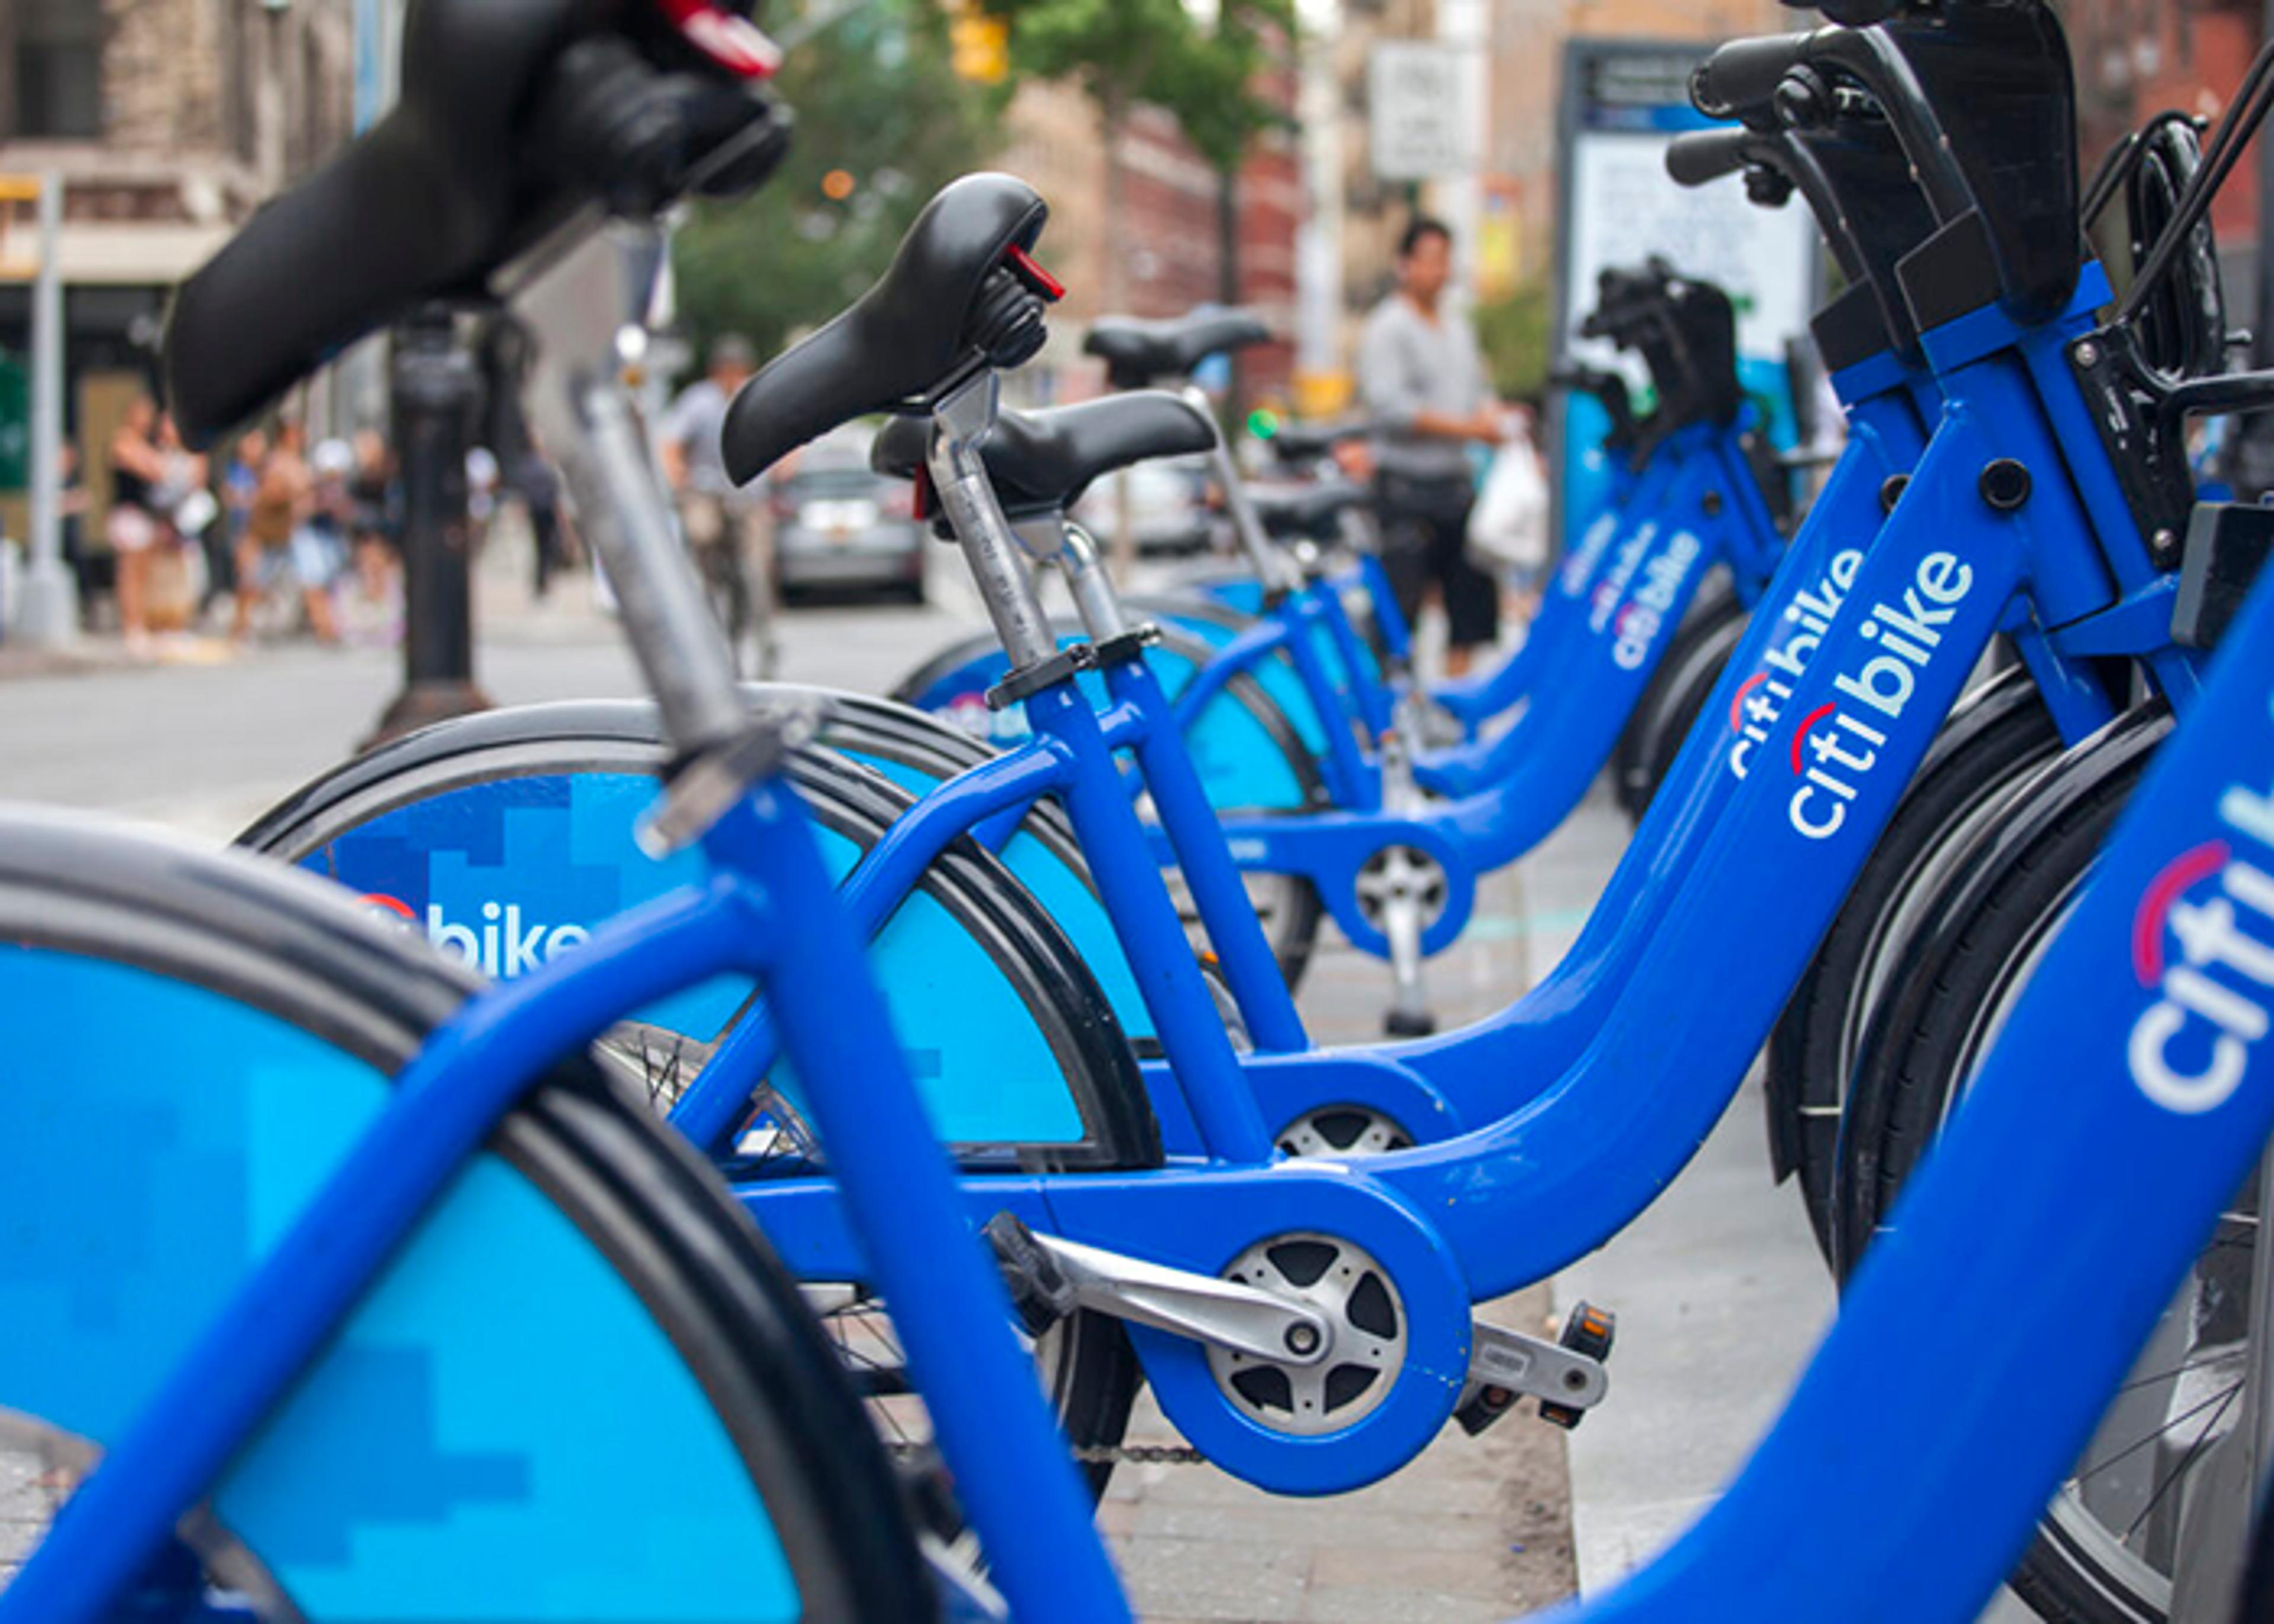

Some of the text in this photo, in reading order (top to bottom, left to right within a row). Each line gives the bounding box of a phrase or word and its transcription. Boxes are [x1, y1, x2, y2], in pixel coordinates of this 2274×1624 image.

[1789, 551, 1973, 839] citi bike
[428, 902, 592, 979] bike
